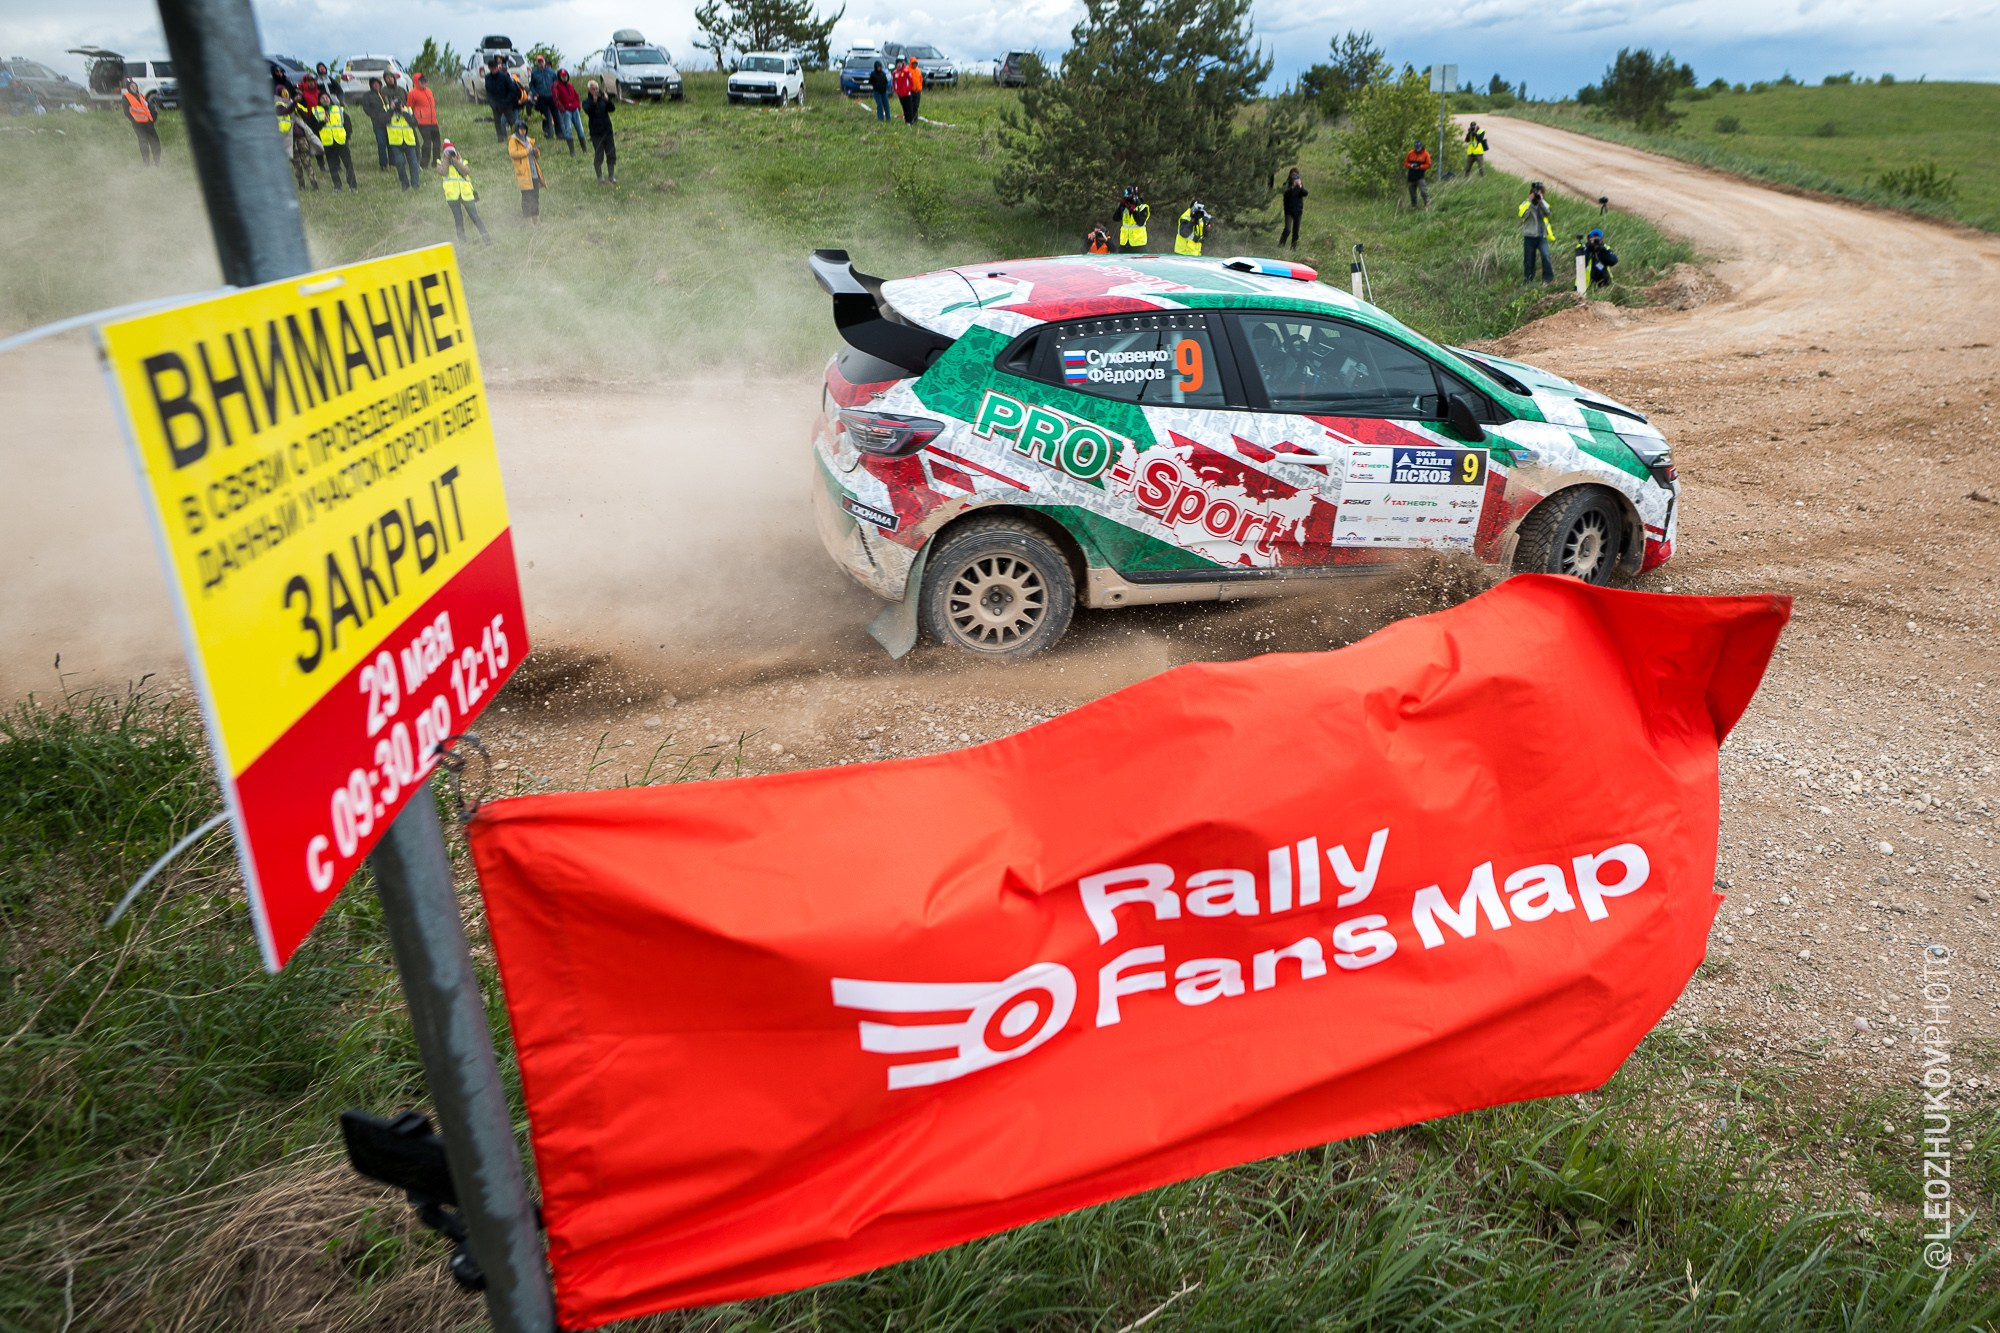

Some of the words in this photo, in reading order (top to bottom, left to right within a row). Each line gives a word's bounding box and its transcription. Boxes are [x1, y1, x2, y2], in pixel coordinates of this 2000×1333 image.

[142, 270, 464, 470] ВНИМАНИЕ!
[1086, 349, 1168, 368] Суховенко
[1087, 368, 1165, 385] Фёдоров
[1175, 339, 1204, 392] 9
[180, 494, 206, 535] В
[208, 449, 291, 520] СВЯЗИ
[290, 441, 310, 476] С
[308, 378, 432, 461] ПРОВЕДЕНИЕМ
[429, 359, 477, 397] РАЛЛИ
[197, 492, 304, 597] ДАННЫЙ
[300, 450, 384, 524] УЧАСТОК
[382, 419, 443, 481] ДОРОГИ
[440, 394, 482, 437] БУДЕТ
[972, 388, 1286, 558] PRO-Sport
[1395, 469, 1451, 483] ПСКОВ
[1416, 457, 1452, 466] РАЛЛИ
[1462, 453, 1479, 483] 9
[284, 465, 466, 674] ЗАКРЫТ
[359, 649, 400, 737] 29
[401, 610, 454, 694] мая
[306, 834, 334, 893] с
[330, 719, 414, 859] 09:30
[413, 693, 451, 780] до
[450, 613, 509, 716] 12:15
[1078, 827, 1390, 945] Rally
[1095, 913, 1397, 1027] Fans
[1410, 842, 1651, 950] Map
